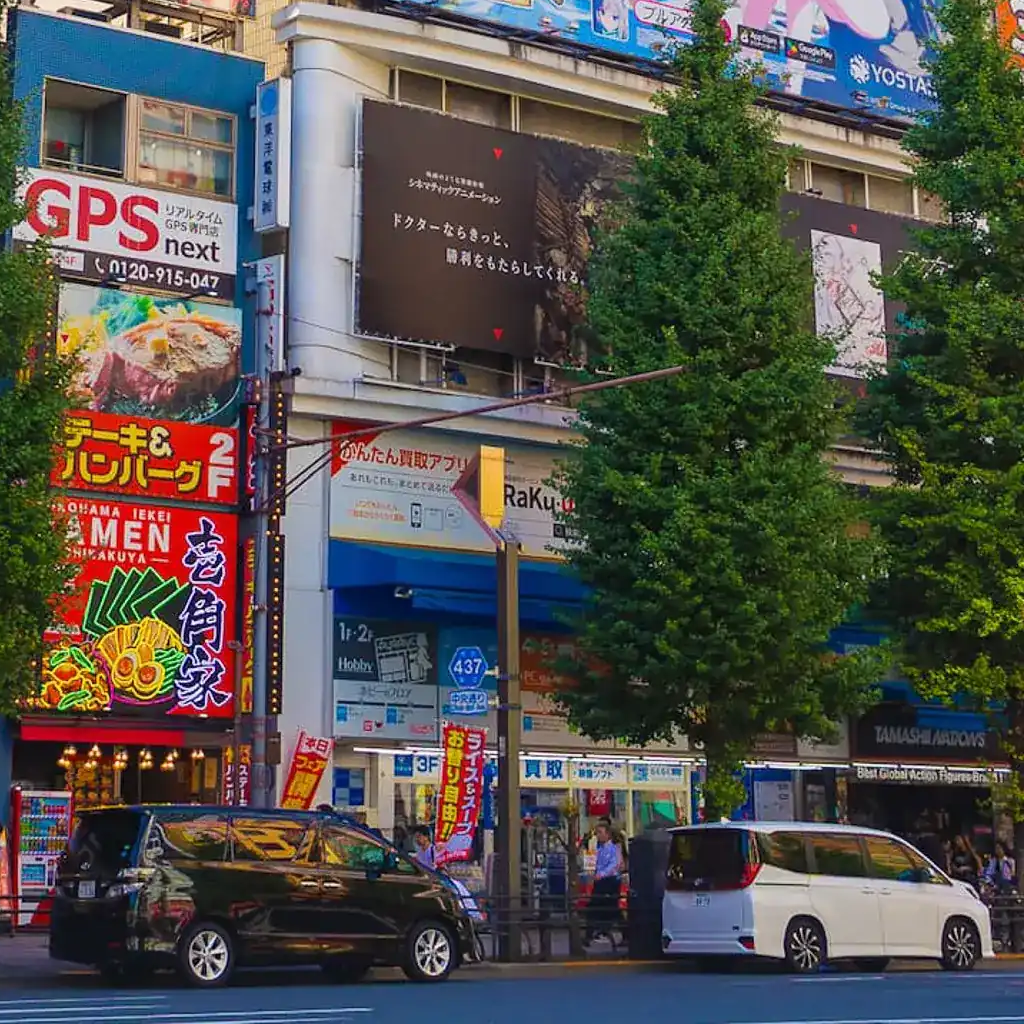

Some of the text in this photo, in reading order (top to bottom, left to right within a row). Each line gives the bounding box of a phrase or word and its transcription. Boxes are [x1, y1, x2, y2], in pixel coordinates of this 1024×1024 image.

[26, 178, 161, 252] GPS
[165, 203, 224, 226] リアルタイム
[392, 212, 511, 248] ドクターならきっと、
[164, 237, 221, 264] next
[446, 247, 585, 286] 勝利をもたらしてくれる。
[109, 258, 220, 290] 0120-915-047
[64, 417, 173, 458] テーキ&
[61, 450, 202, 493] ハンバーグ
[132, 507, 172, 523] IEKEI
[65, 515, 171, 553] AMEN
[338, 656, 373, 670] Hobby
[453, 659, 483, 675] 437
[416, 756, 439, 773] 3F
